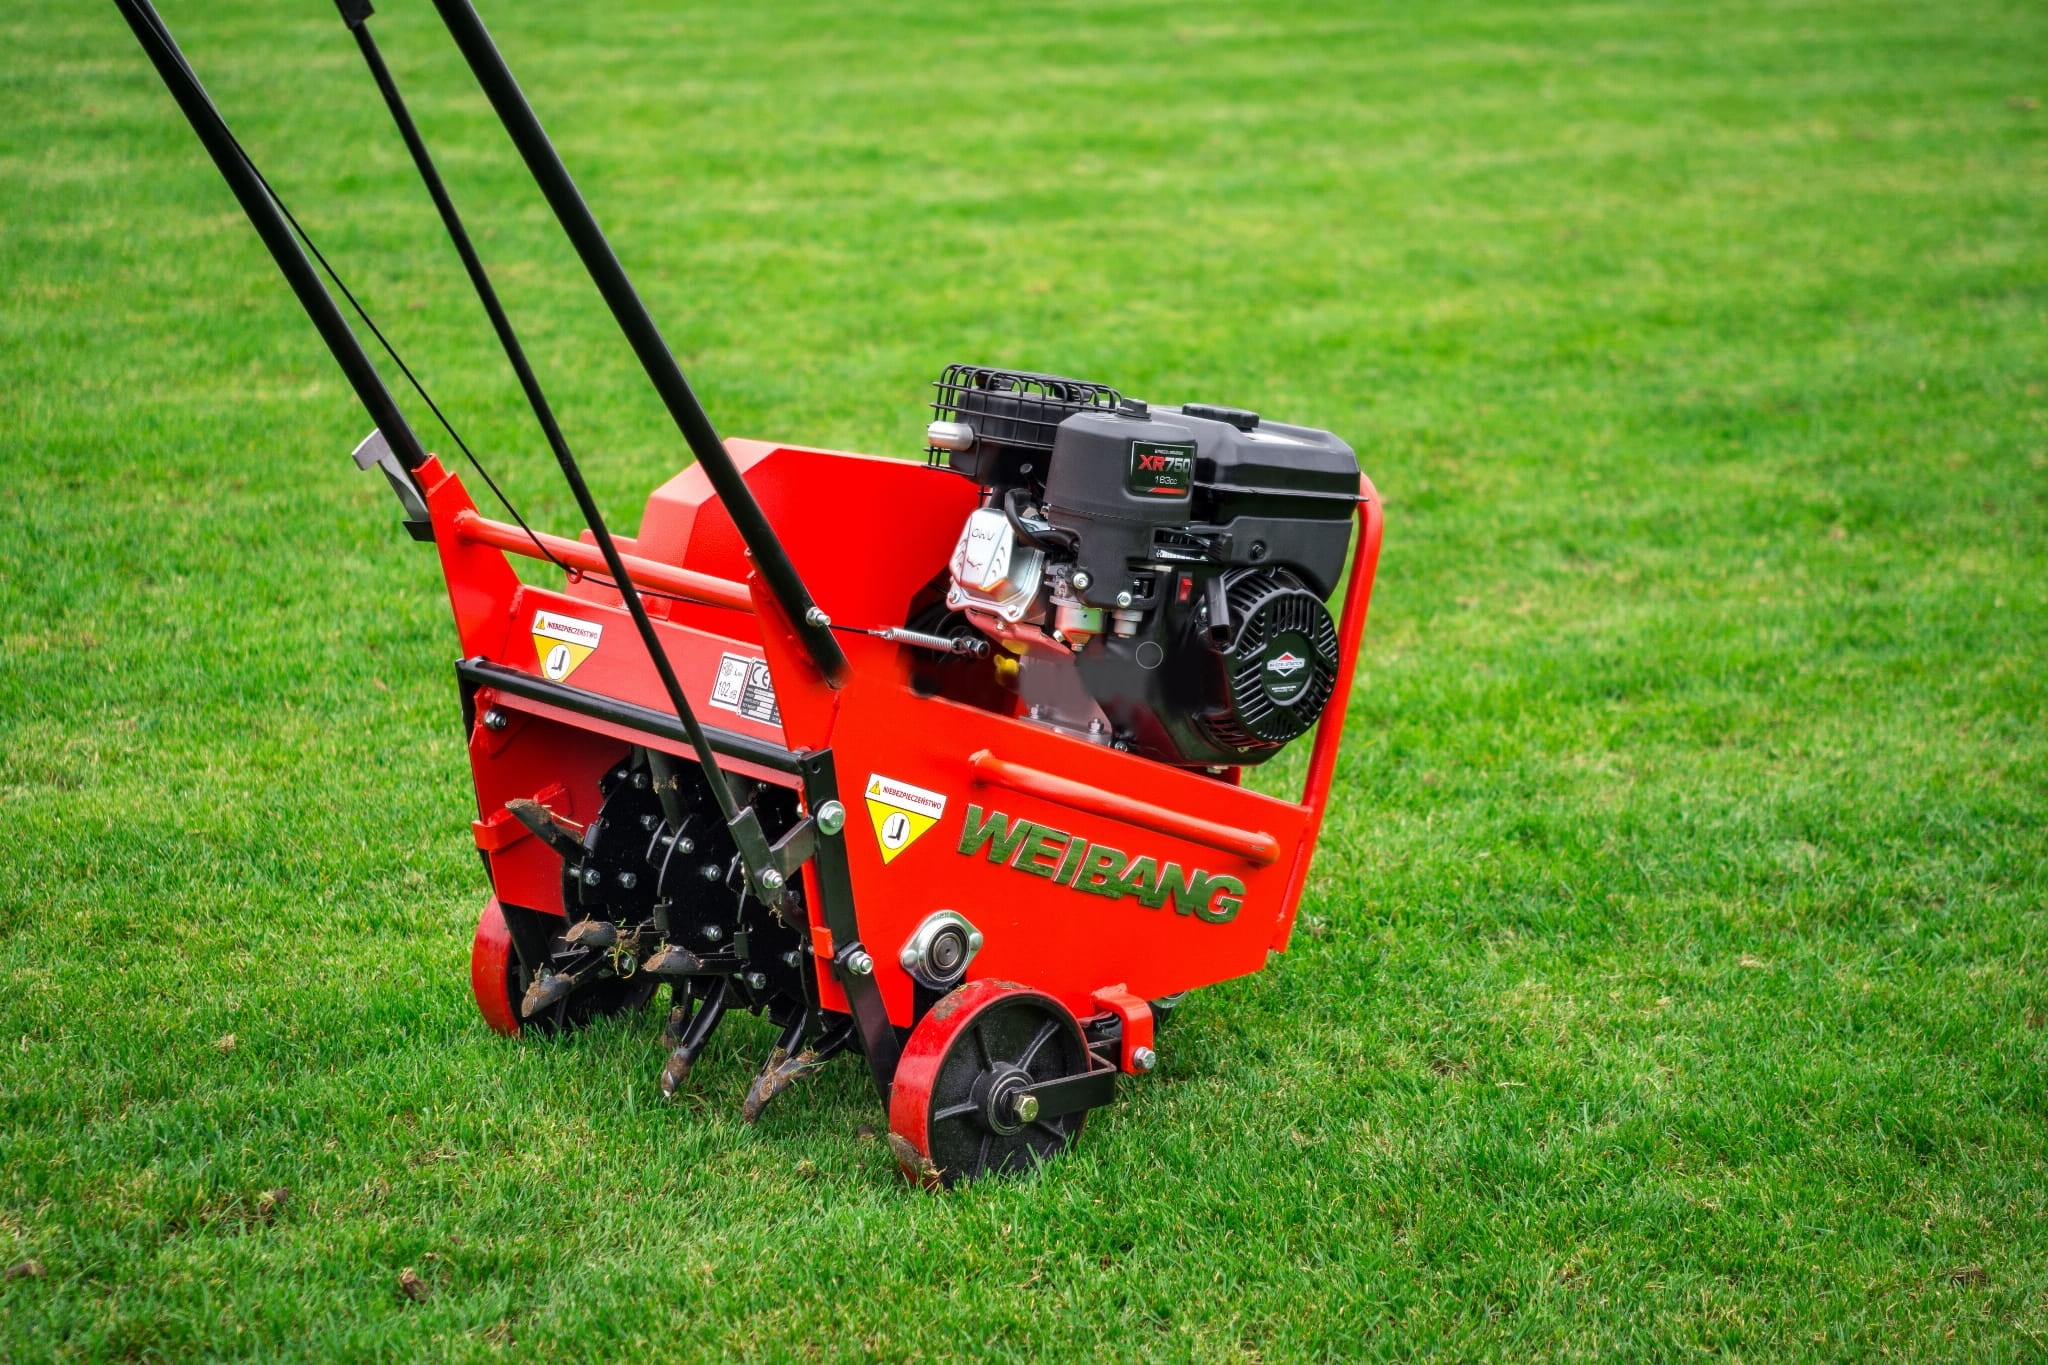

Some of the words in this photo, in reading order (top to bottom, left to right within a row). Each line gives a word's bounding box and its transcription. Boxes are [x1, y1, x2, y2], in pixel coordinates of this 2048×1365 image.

[1138, 454, 1191, 473] XR750
[1154, 475, 1178, 485] 163cc
[882, 785, 942, 810] NIEBEZPIECZEŃSTWO
[957, 803, 1247, 924] WEIBANG
